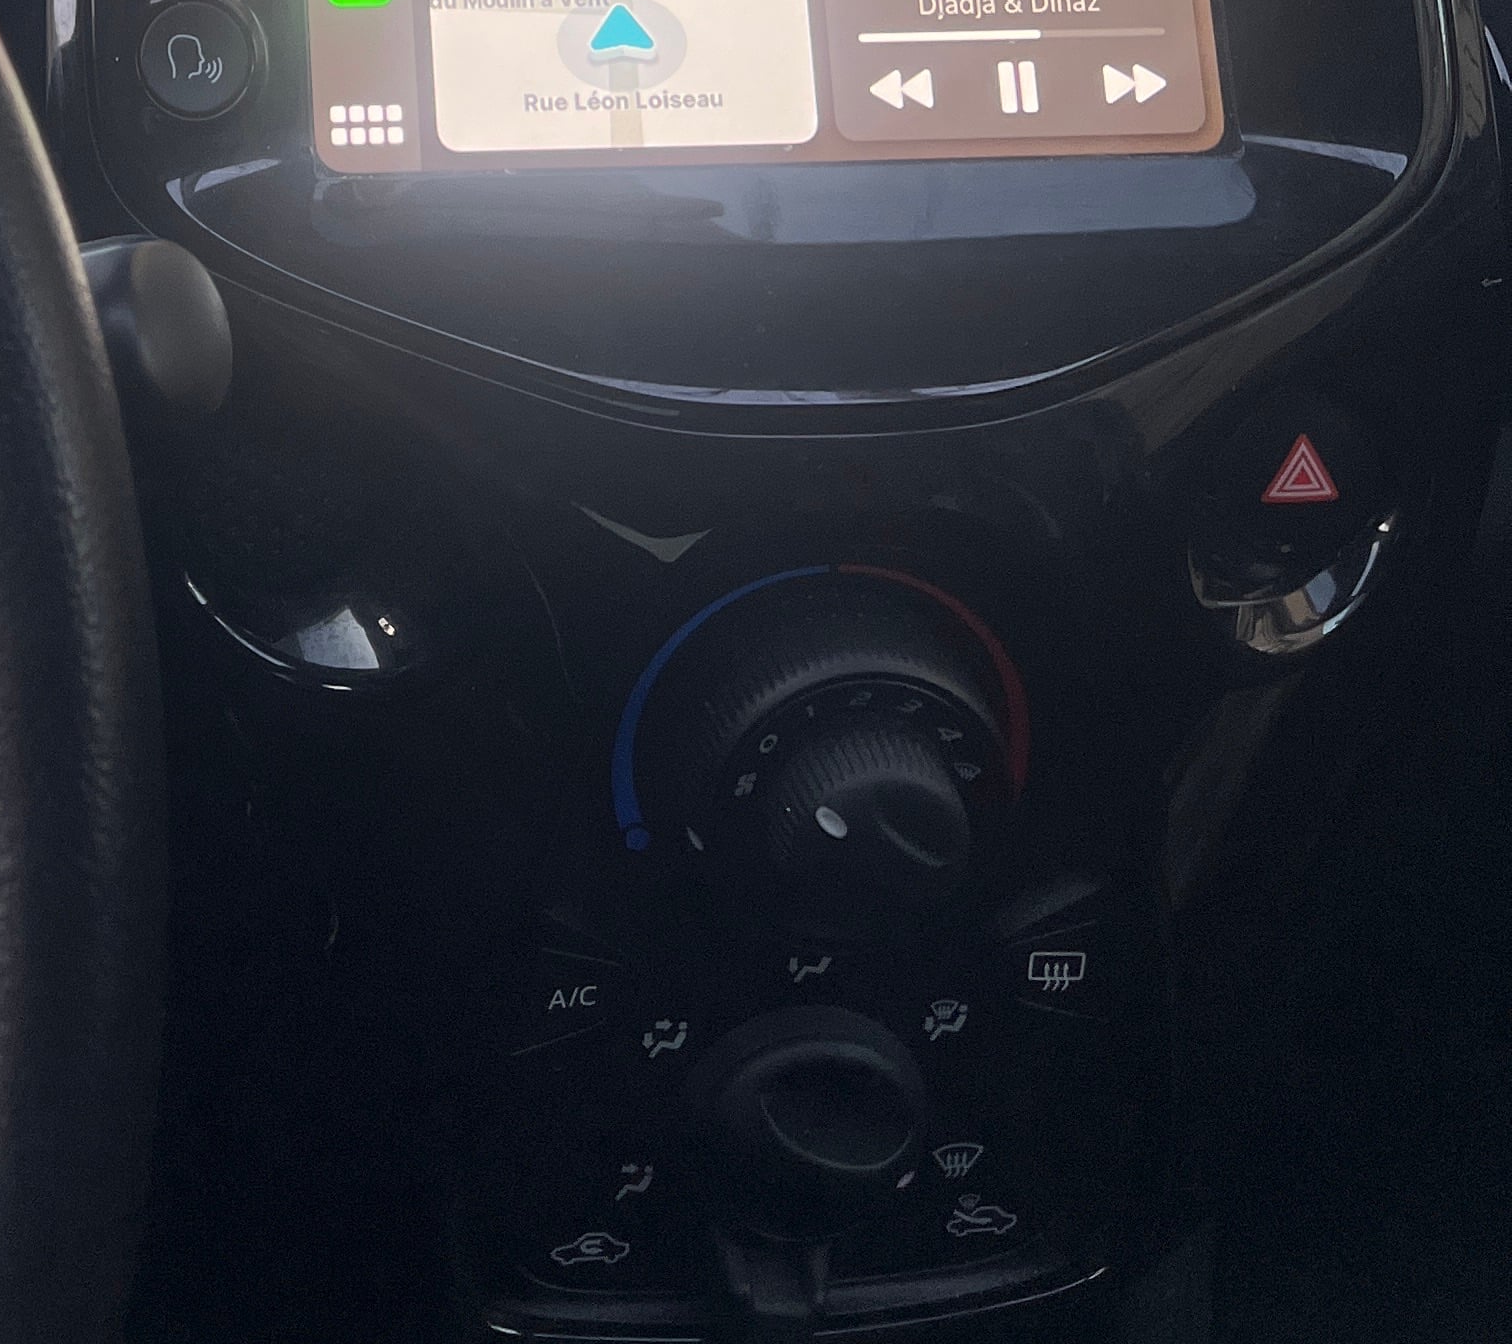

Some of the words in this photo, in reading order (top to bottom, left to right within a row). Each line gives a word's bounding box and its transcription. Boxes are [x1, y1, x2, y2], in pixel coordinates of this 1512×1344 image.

[523, 92, 565, 111] Rue
[574, 87, 628, 111] Léon
[637, 89, 724, 109] Loiseau
[547, 986, 599, 1011] A/C
